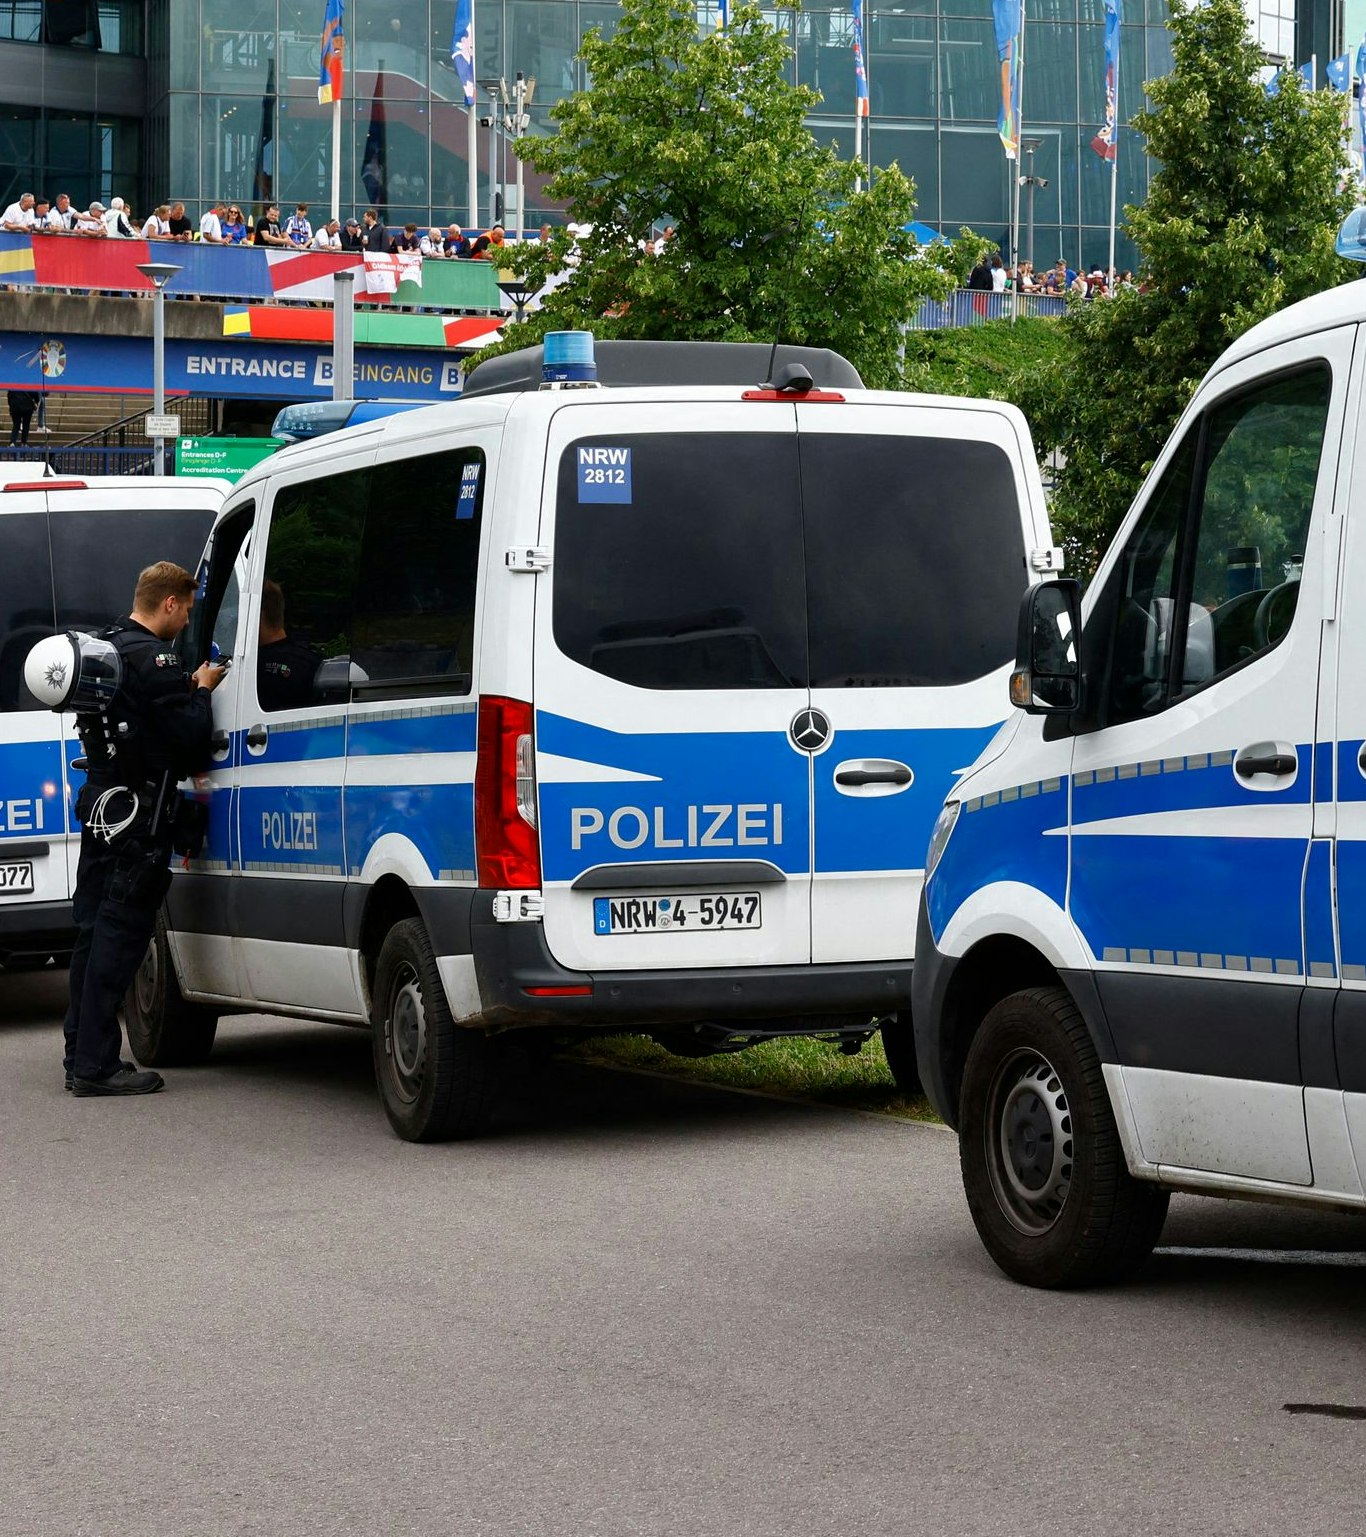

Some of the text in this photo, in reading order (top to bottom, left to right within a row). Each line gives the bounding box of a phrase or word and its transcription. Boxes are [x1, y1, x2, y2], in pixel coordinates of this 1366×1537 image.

[186, 356, 333, 379] ENTRANCE B
[447, 369, 459, 385] B
[579, 449, 628, 465] NRW
[462, 464, 480, 481] NRW
[584, 469, 625, 484] 2812
[460, 485, 476, 499] 2812
[262, 812, 318, 850] POLIZEI
[571, 803, 783, 850] POLIZEI
[600, 895, 759, 930] D NRW 4-5947
